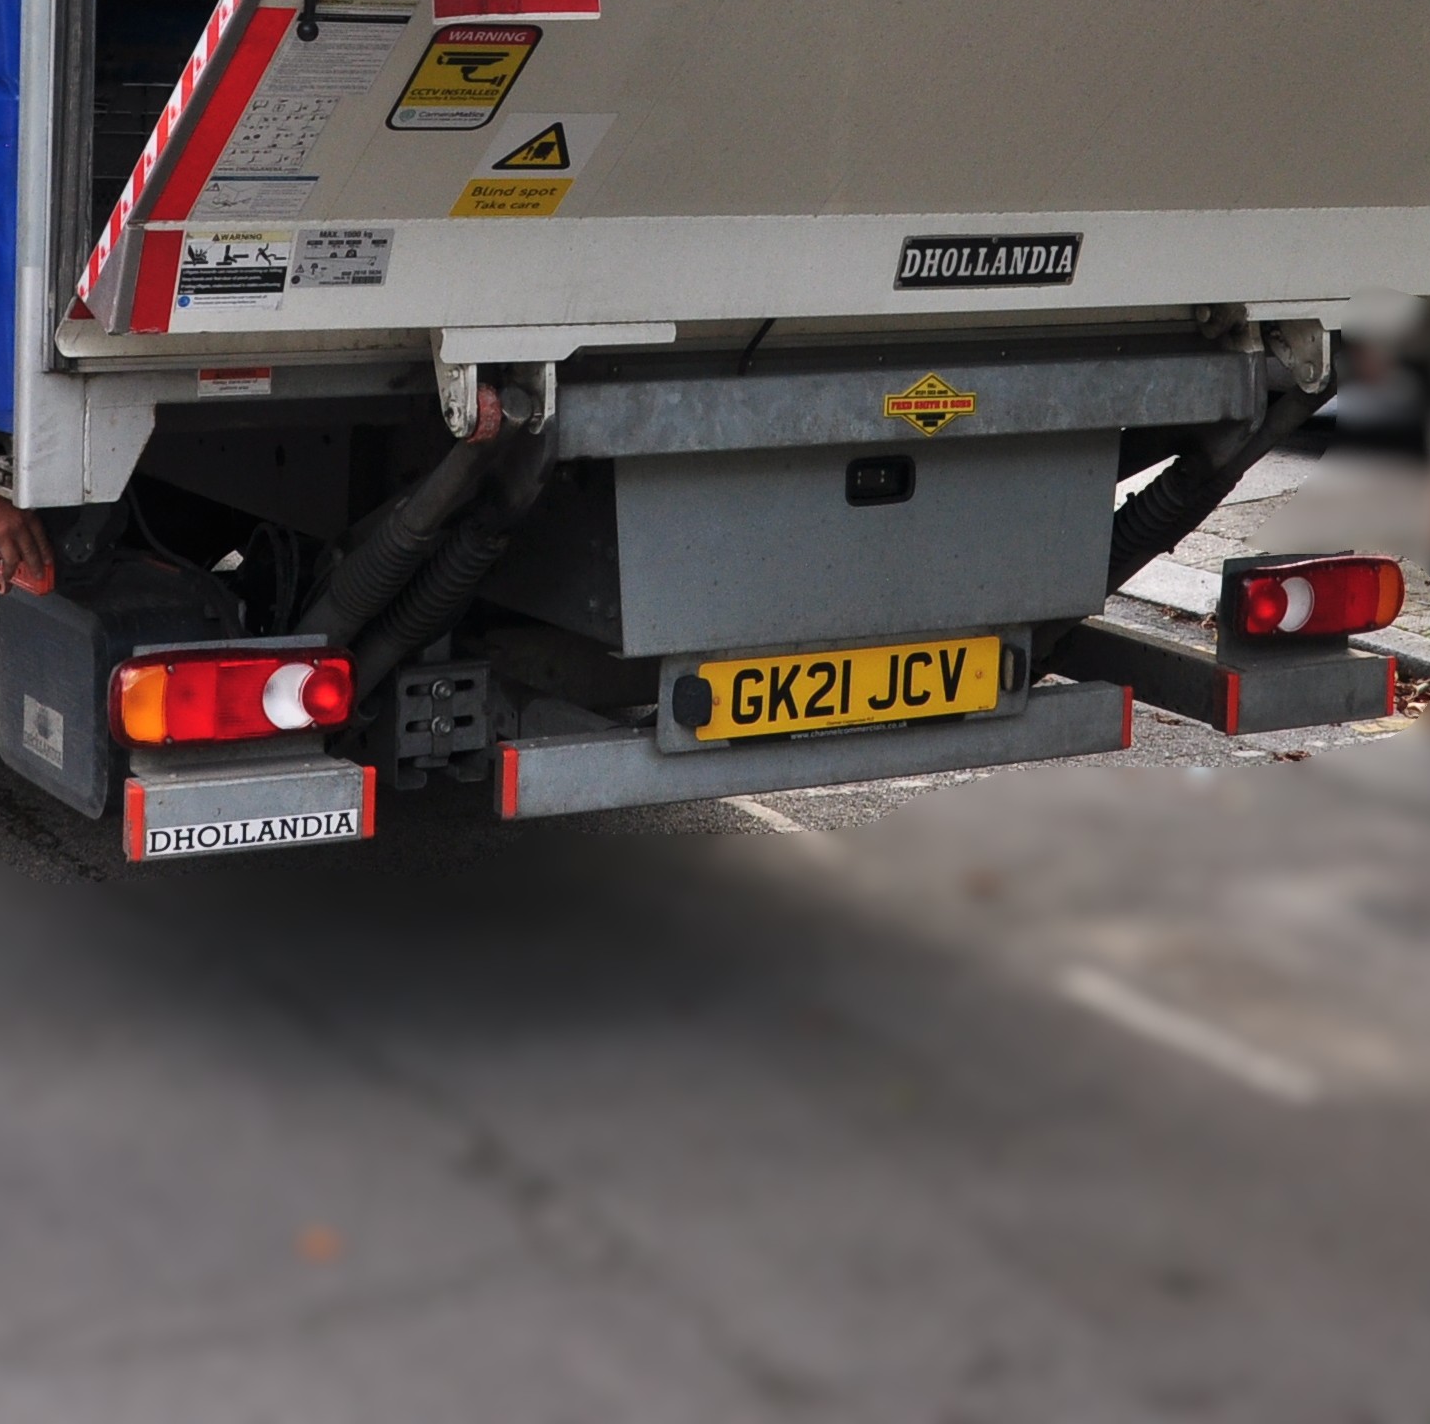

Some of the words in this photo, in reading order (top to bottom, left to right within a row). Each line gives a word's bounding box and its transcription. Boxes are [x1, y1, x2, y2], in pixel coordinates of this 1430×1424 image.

[448, 31, 528, 42] WARNING
[410, 88, 440, 96] CCTV
[441, 88, 500, 96] INSTALLED
[471, 186, 517, 197] Blind
[520, 187, 558, 199] spot
[474, 200, 506, 209] Take
[509, 201, 540, 209] care
[220, 233, 262, 241] WARNING
[901, 245, 1073, 278] DHOLLANDIA
[731, 659, 852, 724] GK21
[867, 647, 967, 710] JCV
[790, 720, 908, 740] www.channelcommercials.co.uk
[149, 812, 355, 854] DHOLLANDIA
